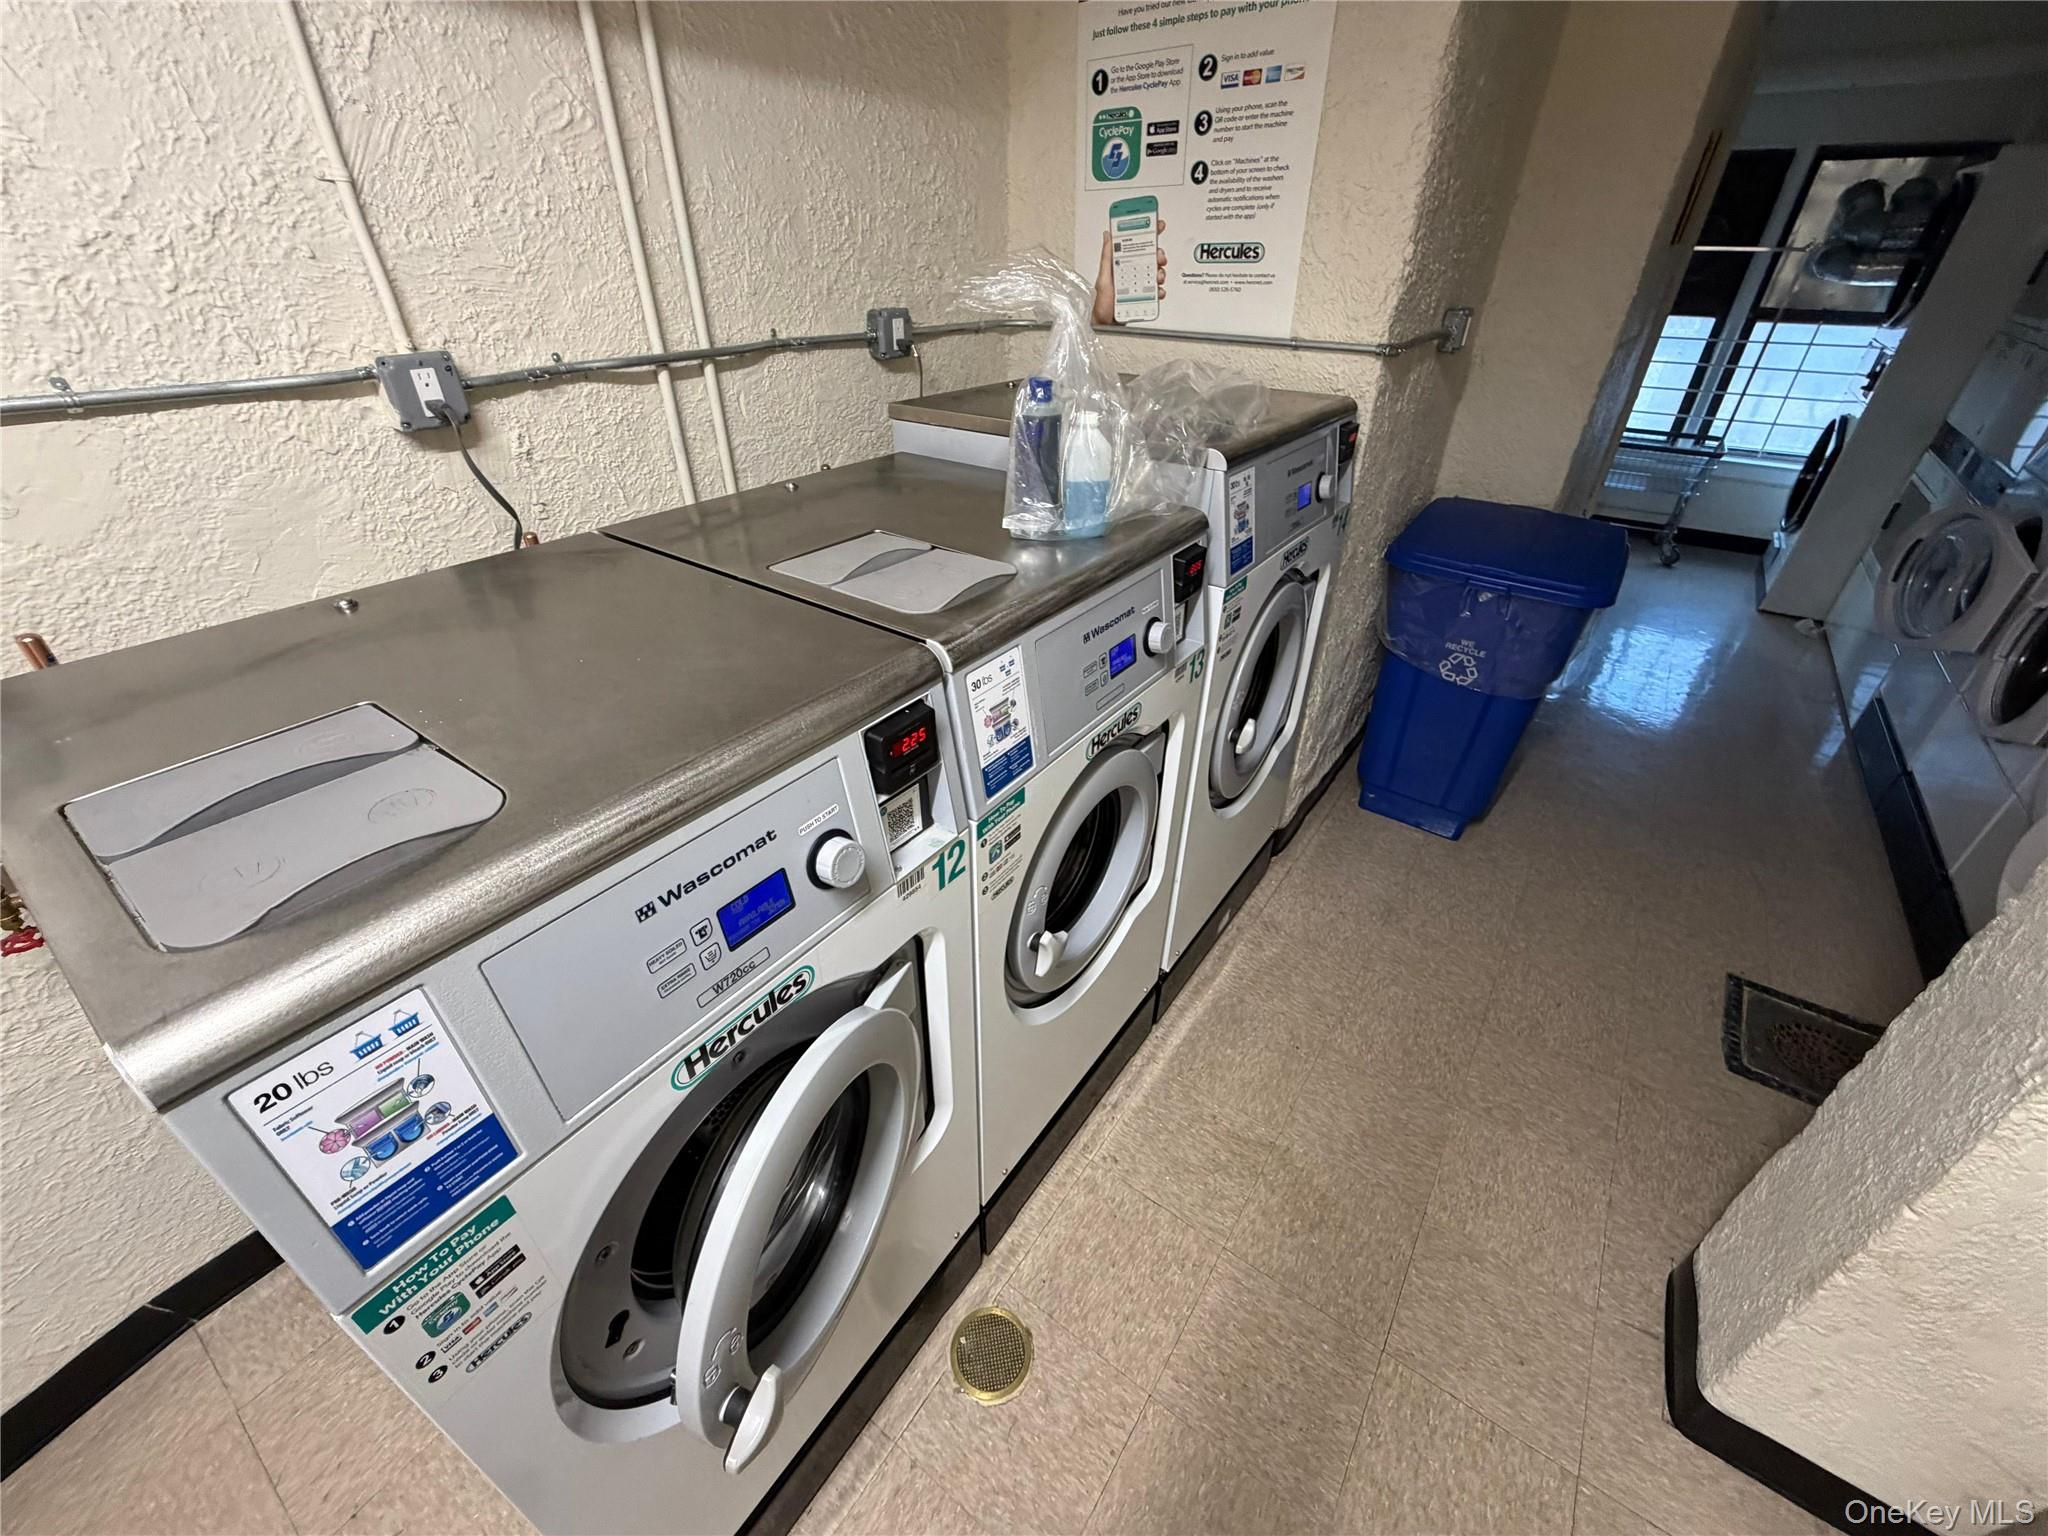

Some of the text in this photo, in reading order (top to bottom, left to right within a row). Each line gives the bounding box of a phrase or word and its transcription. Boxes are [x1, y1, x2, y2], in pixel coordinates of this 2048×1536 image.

[1134, 7, 1145, 16] you
[1146, 2, 1160, 11] tried
[1092, 0, 1278, 40] Just follow these 4 simple steps to pay with your
[1135, 62, 1154, 71] Google
[1166, 58, 1180, 66] Store
[1221, 54, 1233, 62] Sign
[1157, 67, 1184, 77] download
[1224, 73, 1239, 83] VISA
[1143, 80, 1169, 91] CyclePay
[1270, 110, 1294, 118] machine
[1099, 125, 1134, 138] CyclePay
[1264, 120, 1288, 128] machine
[1218, 177, 1245, 185] availability
[1263, 174, 1284, 182] washers
[1200, 243, 1260, 260] Hercules
[1091, 606, 1136, 638] Wascomat
[1445, 642, 1487, 658] RECYCLE
[1189, 648, 1205, 684] 13
[971, 674, 993, 693] 30 lbs
[1091, 706, 1138, 754] Hercules
[800, 821, 814, 833] PUSH
[822, 805, 837, 819] START
[657, 828, 777, 907] Wascomat
[932, 839, 966, 891] 12
[648, 954, 665, 967] HEAVY
[713, 961, 755, 994] W720cc
[684, 974, 807, 1080] Hercules
[254, 1062, 333, 1112] 20 lbs
[379, 1285, 417, 1313] With
[418, 1254, 452, 1282] Your
[455, 1219, 498, 1254] Phone
[392, 1225, 475, 1292] How To Pay
[471, 1313, 531, 1368] Hercules
